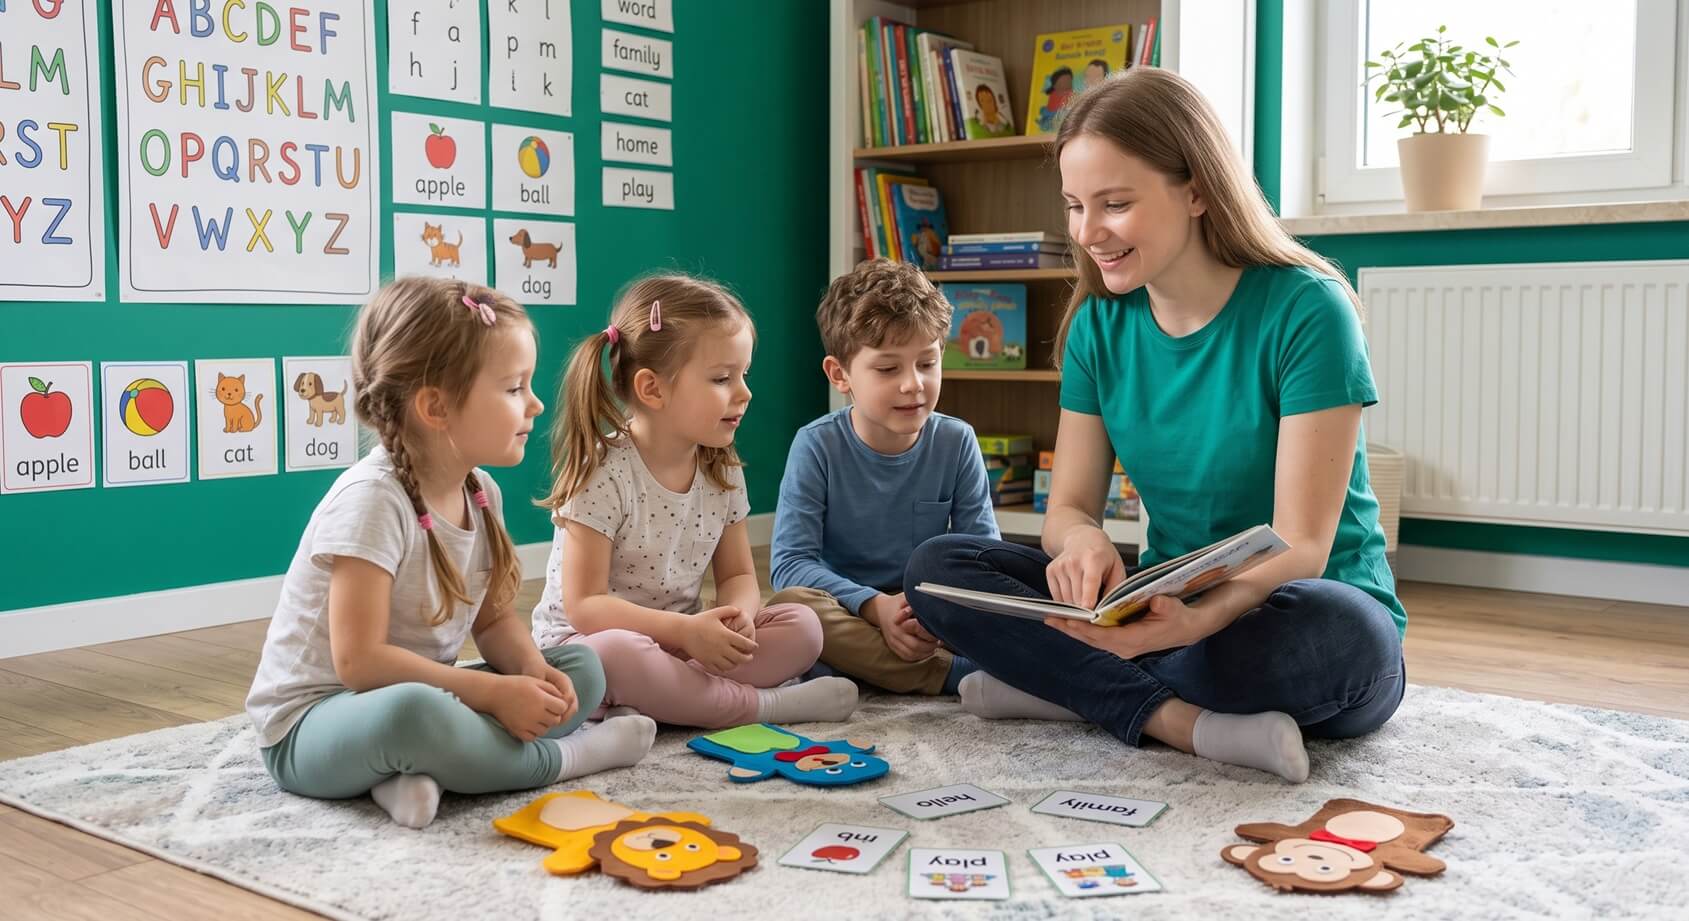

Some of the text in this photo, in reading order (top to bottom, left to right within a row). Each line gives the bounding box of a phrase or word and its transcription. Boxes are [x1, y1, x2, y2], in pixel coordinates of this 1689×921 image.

[617, 0, 657, 20] word
[411, 11, 461, 43] f a
[507, 35, 557, 60] p m
[613, 38, 661, 71] family
[410, 51, 458, 91] h j
[142, 56, 355, 123] GHIJKLM
[543, 72, 554, 97] k
[624, 90, 649, 108] cat
[616, 132, 659, 155] home
[140, 129, 361, 189] OPQRSTU
[415, 175, 466, 201] apple
[520, 184, 551, 205] ball
[622, 177, 654, 203] play
[521, 275, 552, 299] dog
[128, 448, 167, 471] ball
[223, 444, 255, 464] cat
[305, 437, 339, 460] dog
[16, 452, 80, 482] apple
[916, 793, 977, 808] hello
[1059, 798, 1138, 817] family
[929, 856, 987, 868] play
[1056, 850, 1112, 863] play
